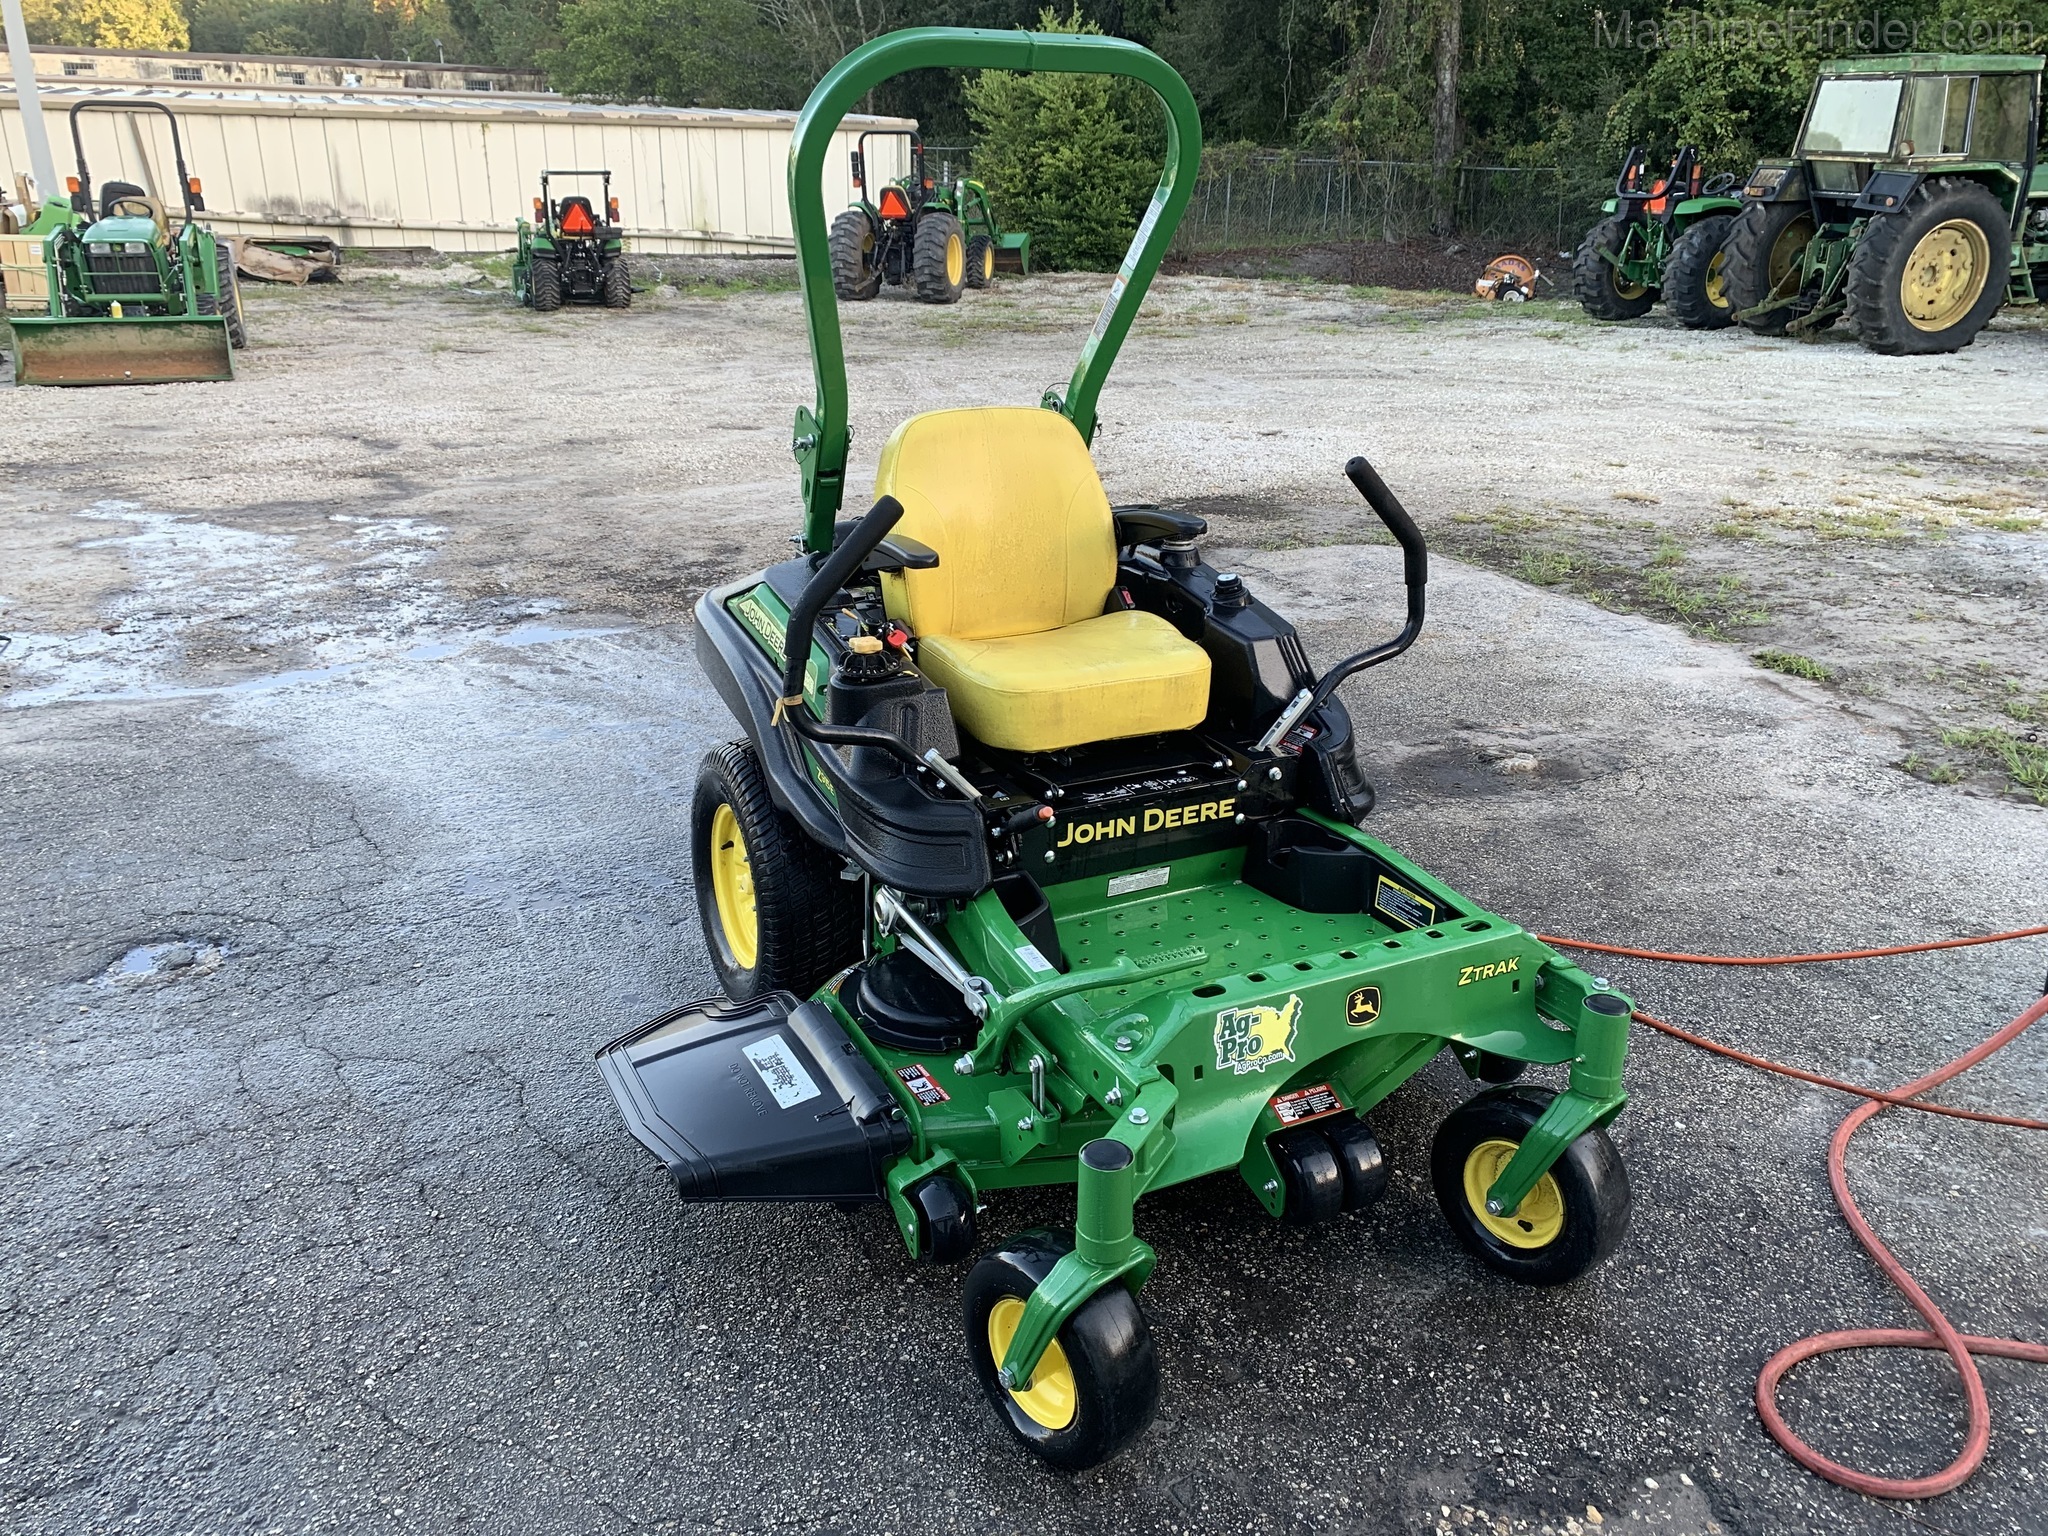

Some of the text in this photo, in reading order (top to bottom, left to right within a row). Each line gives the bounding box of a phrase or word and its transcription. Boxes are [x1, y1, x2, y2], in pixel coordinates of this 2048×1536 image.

[744, 603, 766, 634] JOHN
[1057, 798, 1236, 848] JOHN DEERE
[1458, 956, 1520, 987] ZTRAK
[1219, 1011, 1261, 1041] Ag-
[1220, 1034, 1263, 1066] Pro
[1236, 1052, 1284, 1073] AgProCo.com
[728, 1062, 769, 1117] DO NOT REMOVE
